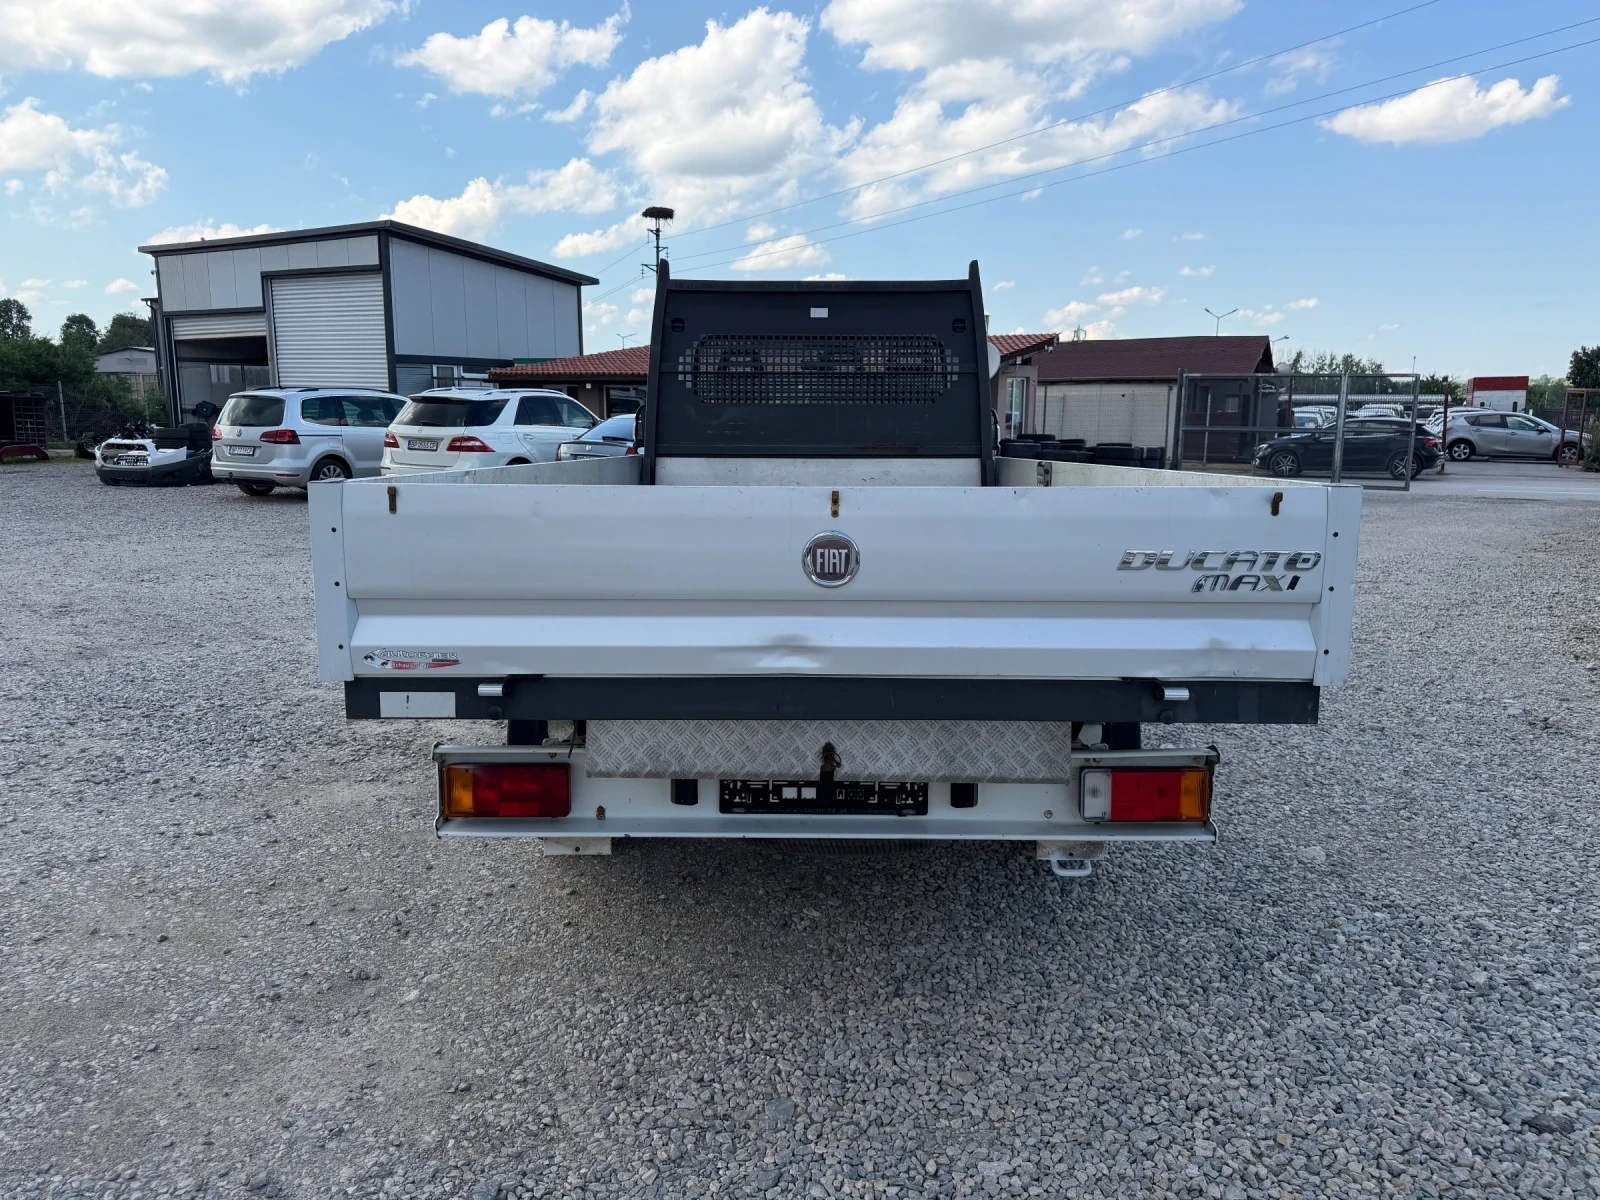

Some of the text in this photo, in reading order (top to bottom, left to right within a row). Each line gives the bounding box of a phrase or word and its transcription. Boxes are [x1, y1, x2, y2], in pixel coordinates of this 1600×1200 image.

[816, 548, 848, 574] FIAT
[1116, 549, 1322, 571] DUCATO
[1191, 574, 1301, 593] MAXI
